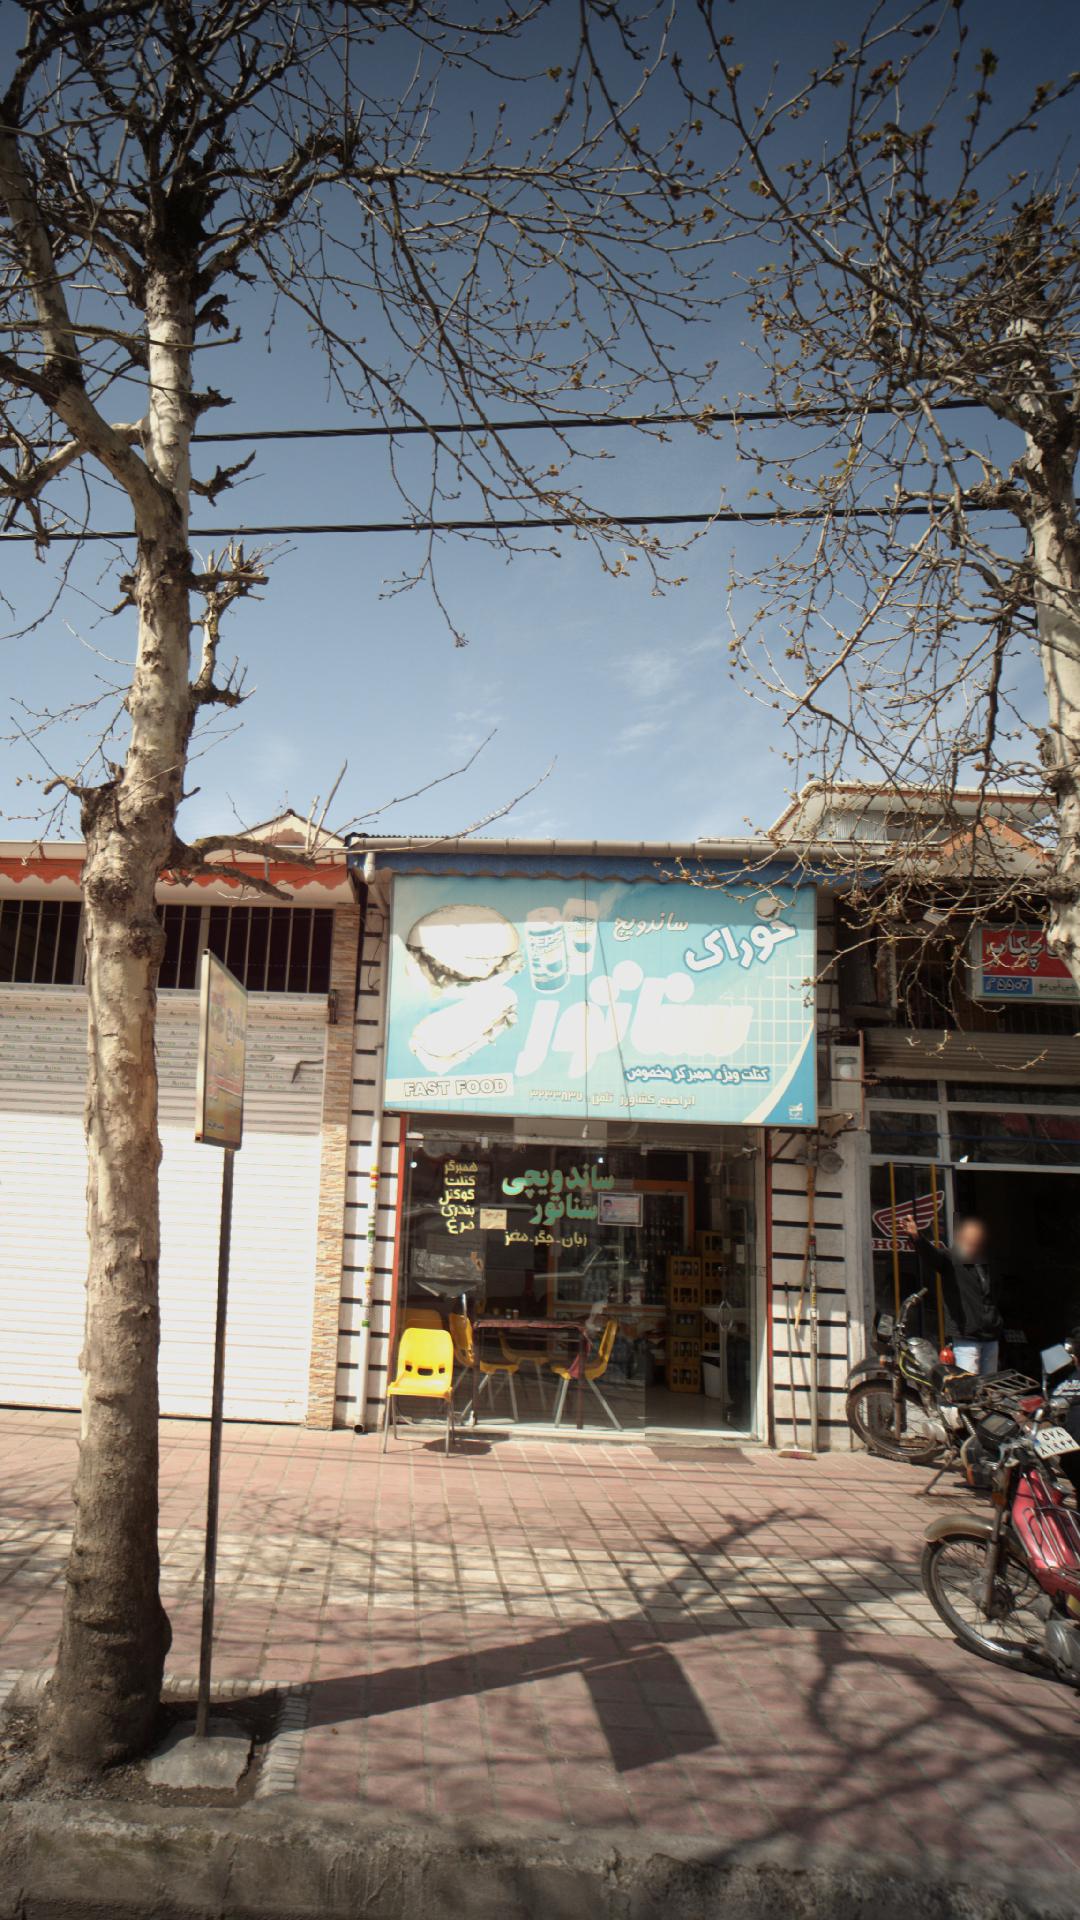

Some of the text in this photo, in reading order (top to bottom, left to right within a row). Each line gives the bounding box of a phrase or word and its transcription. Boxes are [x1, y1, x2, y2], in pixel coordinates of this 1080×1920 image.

[613, 912, 688, 941] ساندویچ
[684, 919, 797, 972] خوراک
[515, 959, 753, 1079] سناتور
[625, 1065, 673, 1081] مخصوص
[715, 1064, 741, 1084] ویژه
[741, 1067, 769, 1081] کتلت
[404, 1079, 508, 1097] FAST FOOD
[445, 1160, 479, 1175] همبرگر
[445, 1176, 476, 1186] کتلت
[502, 1163, 615, 1199] ساندویچی
[439, 1189, 475, 1205] کوکتل
[441, 1204, 475, 1217] بندری
[529, 1193, 598, 1225] سناتور
[446, 1216, 475, 1234] مرغ
